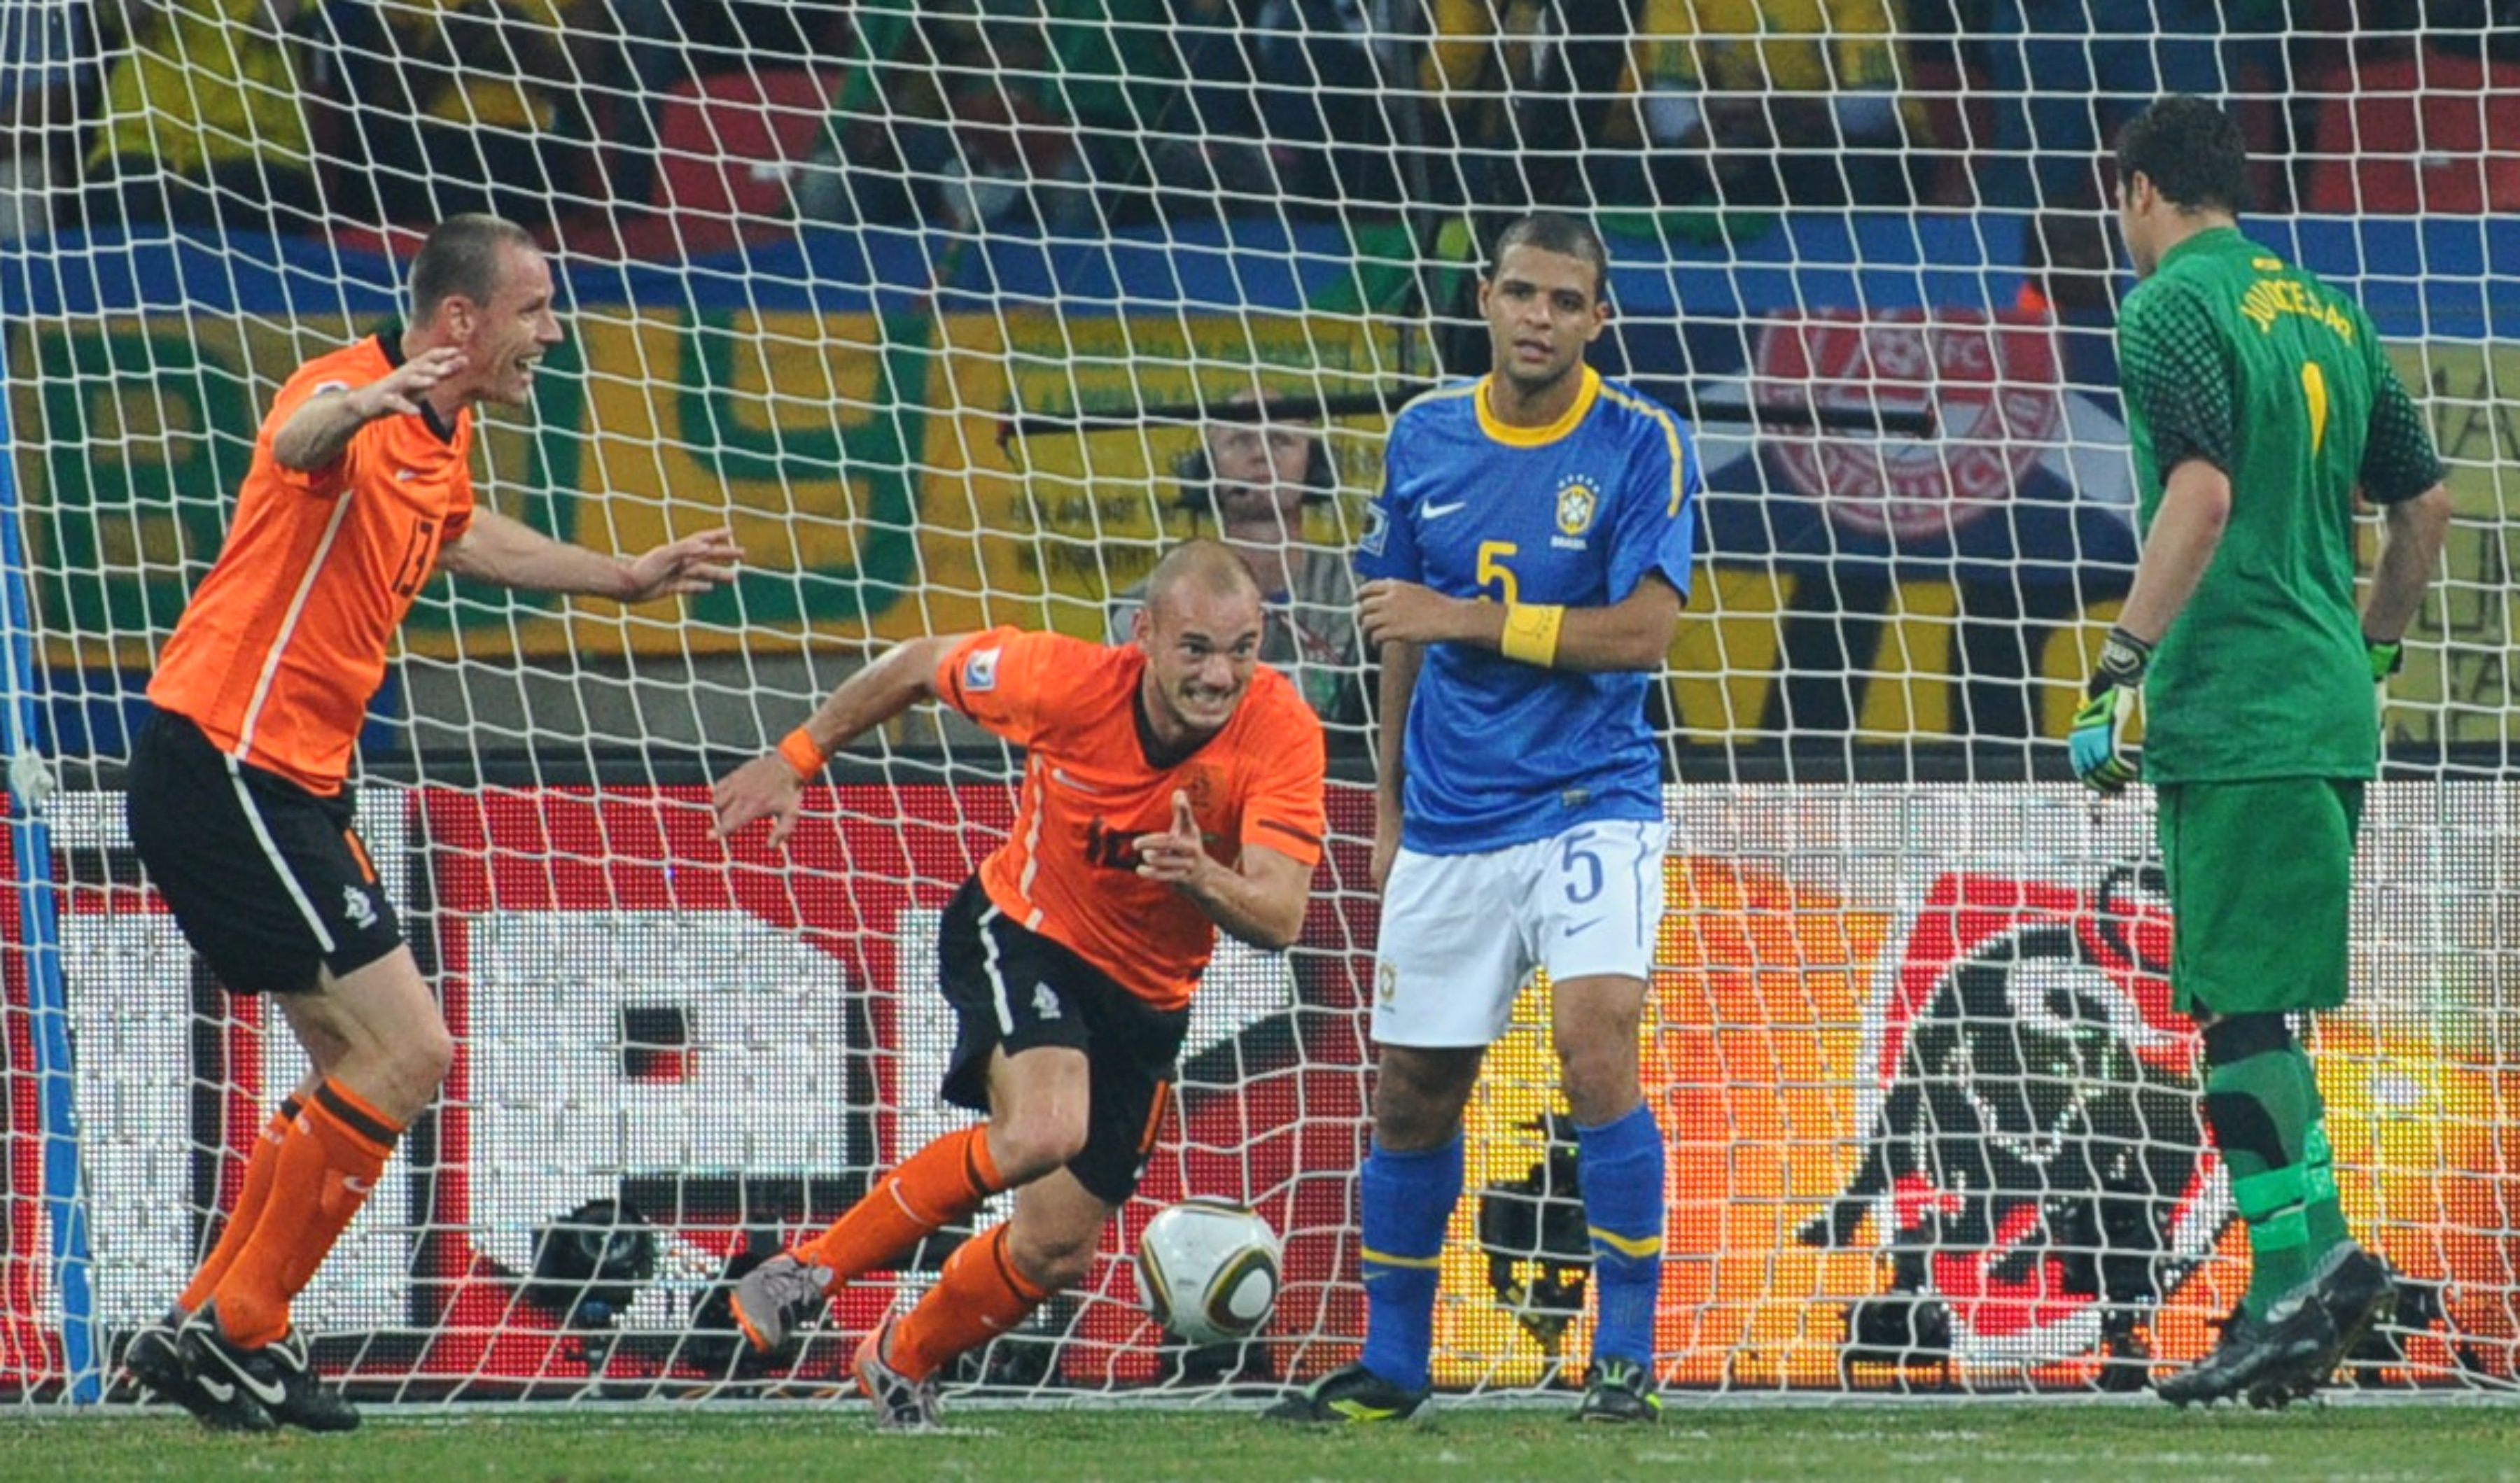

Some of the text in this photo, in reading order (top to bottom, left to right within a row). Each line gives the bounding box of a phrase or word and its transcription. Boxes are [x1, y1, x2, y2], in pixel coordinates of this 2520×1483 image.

[391, 514, 434, 598] 13
[1476, 540, 1518, 606] 5
[1562, 829, 1604, 904] 5
